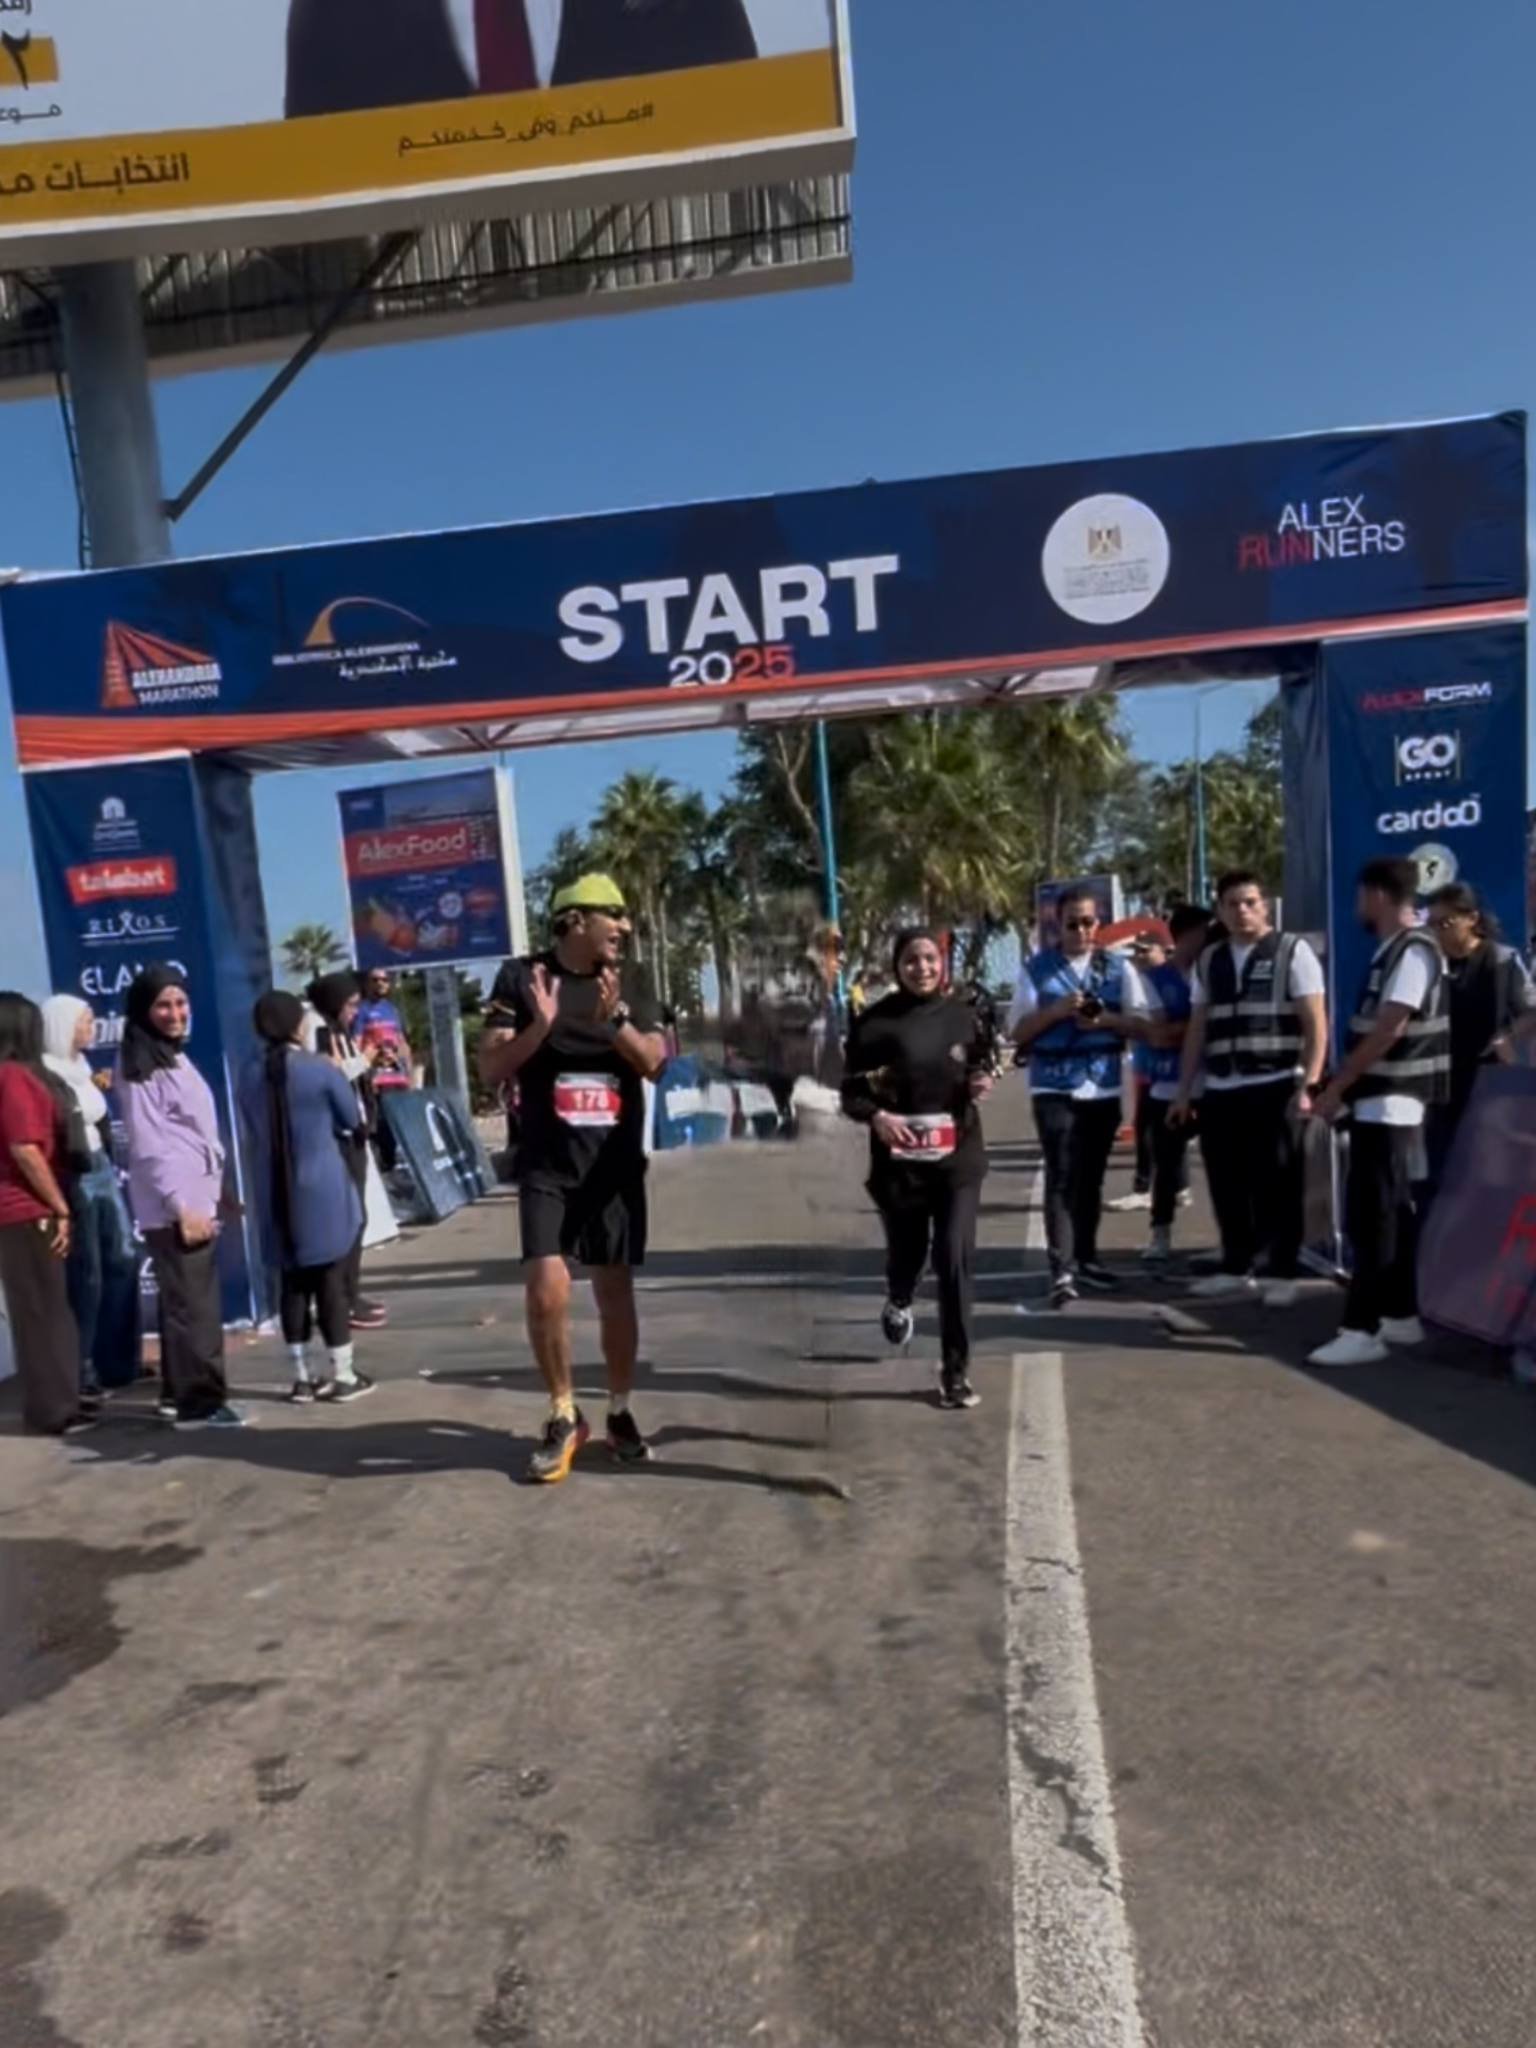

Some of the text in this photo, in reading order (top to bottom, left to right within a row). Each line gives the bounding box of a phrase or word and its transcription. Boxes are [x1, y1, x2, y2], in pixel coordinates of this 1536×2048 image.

[46, 152, 190, 194] انتخابات
[1278, 494, 1366, 535] ALEX
[1237, 520, 1406, 570] RUNNERS
[557, 553, 899, 663] START
[668, 644, 795, 688] 2025
[139, 684, 220, 704] MARATHON
[1399, 734, 1456, 769] GO
[79, 865, 166, 892] talabat
[88, 910, 167, 935] RIXOS
